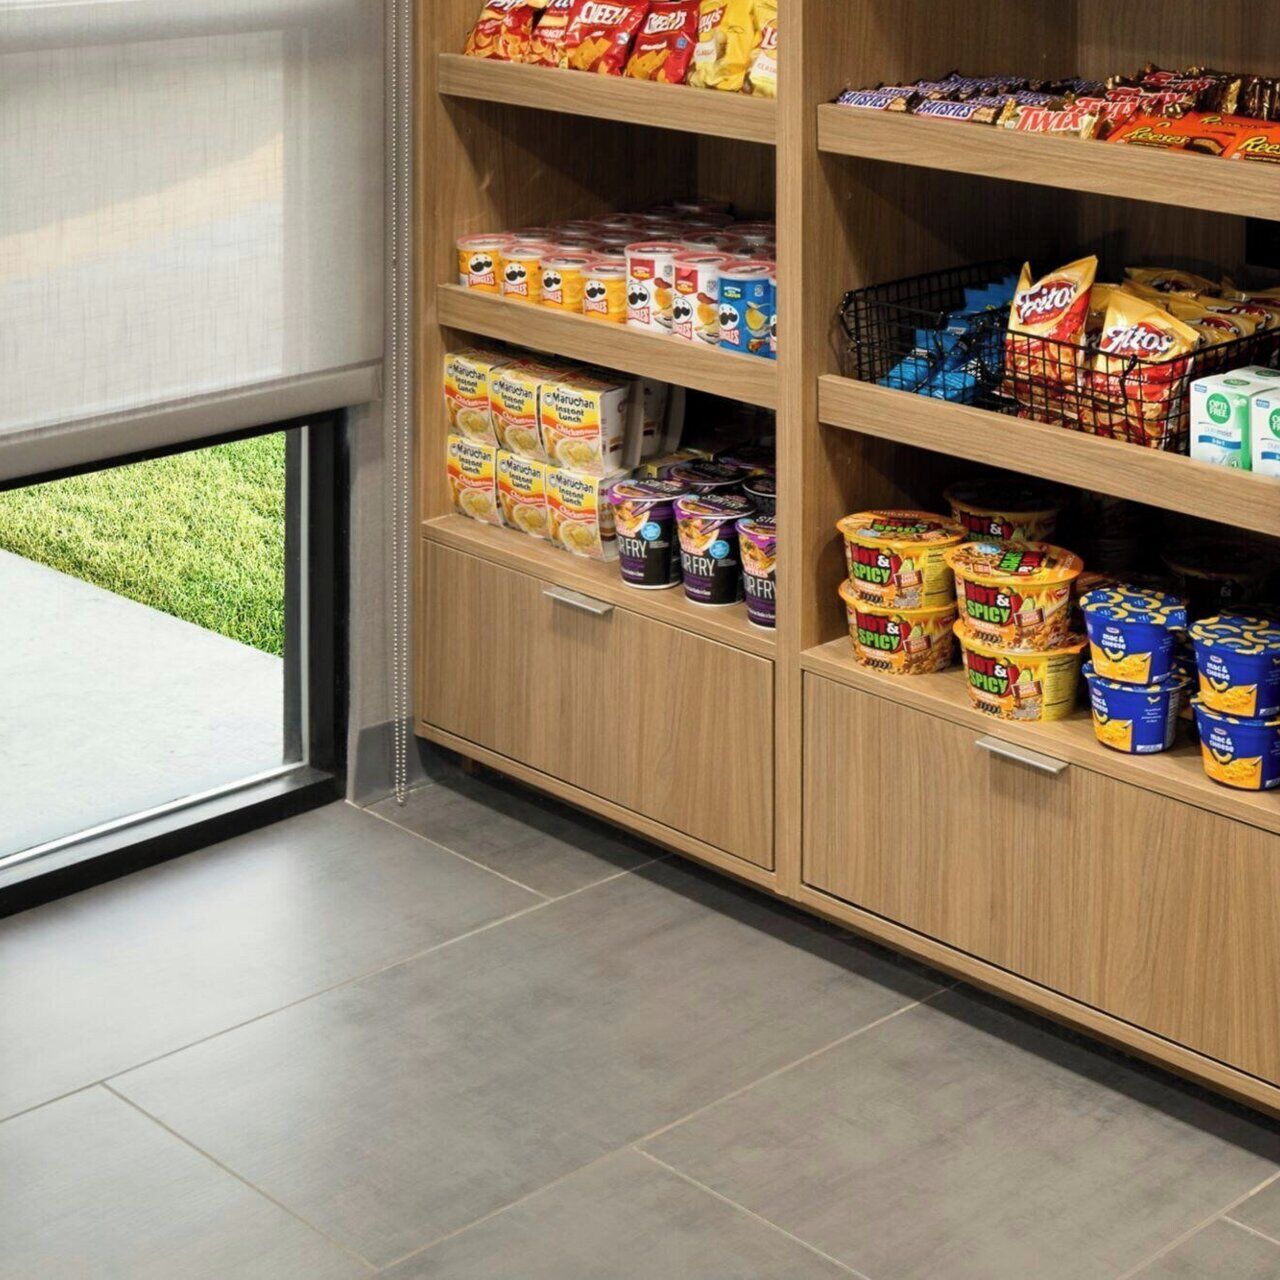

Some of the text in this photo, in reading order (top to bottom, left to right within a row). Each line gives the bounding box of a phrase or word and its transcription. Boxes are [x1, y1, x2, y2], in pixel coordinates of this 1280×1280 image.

[1014, 283, 1077, 324] Fritos
[453, 363, 486, 383] Maruchan
[458, 382, 476, 395] Lunch
[498, 380, 533, 400] Maruchan
[504, 400, 523, 413] Lunch
[553, 392, 595, 411] Maruchan
[1209, 399, 1227, 410] OPTI
[558, 412, 582, 424] Lunch
[1209, 407, 1228, 418] FREE
[457, 443, 492, 463] Maruchan
[461, 463, 481, 476] Lunch
[506, 459, 542, 480] Maruchan
[512, 479, 532, 492] Lunch
[556, 473, 594, 494] Maruchan
[561, 494, 583, 507] Lunch
[625, 539, 647, 559] FRY
[692, 557, 715, 577] FRY
[877, 554, 890, 568] &
[852, 561, 891, 584] SPICY
[996, 594, 1011, 607] &
[966, 600, 1011, 624] SPICY
[886, 622, 900, 635] &
[858, 627, 901, 651] SPICY
[993, 664, 1008, 678] &
[968, 669, 1009, 695] SPICY
